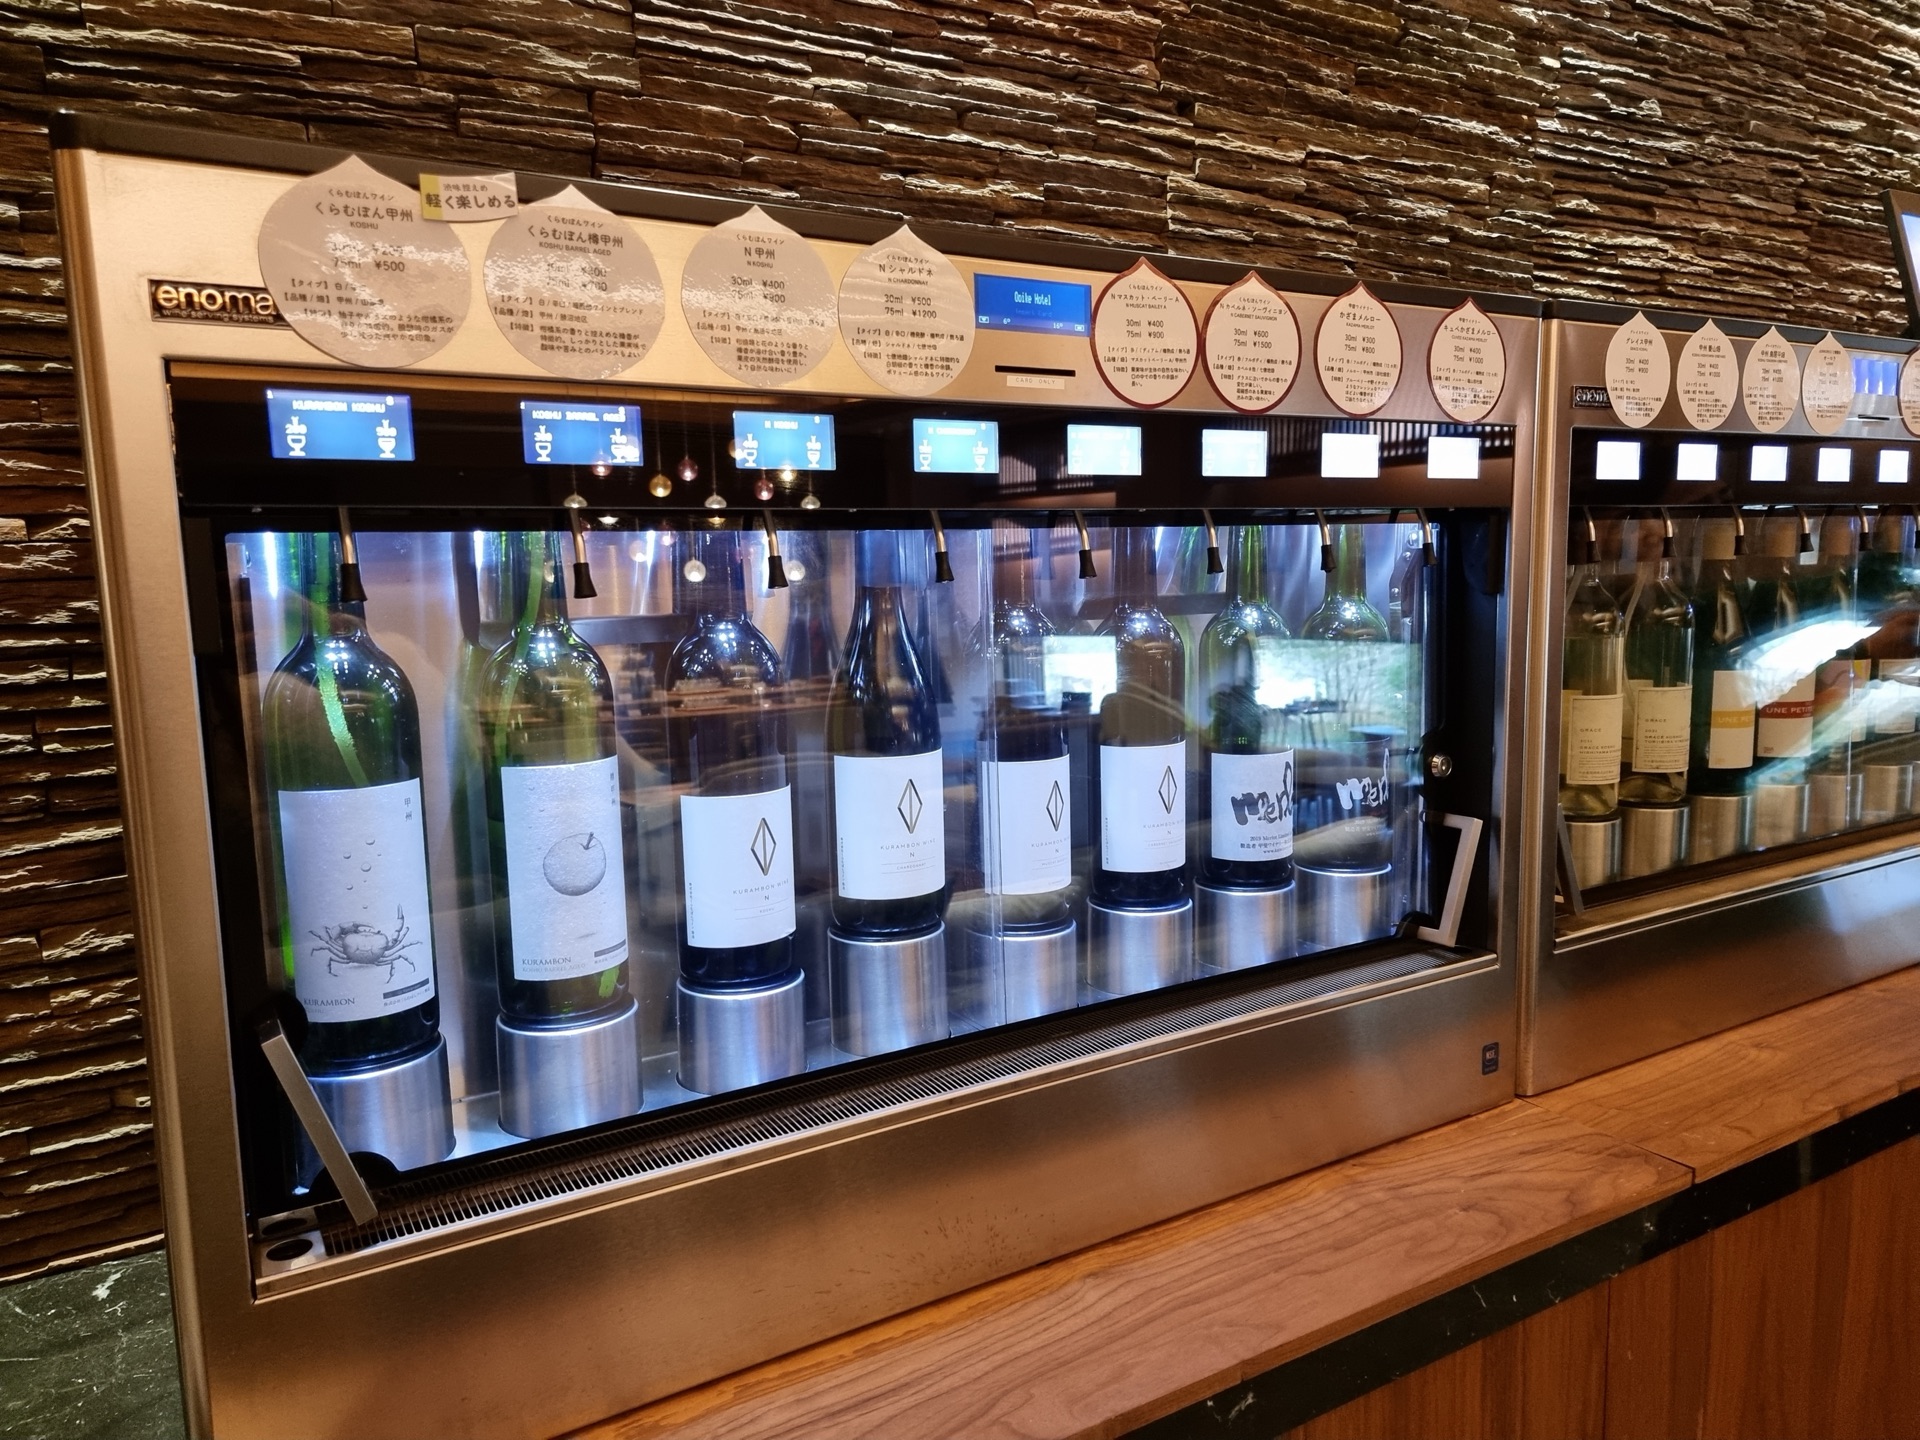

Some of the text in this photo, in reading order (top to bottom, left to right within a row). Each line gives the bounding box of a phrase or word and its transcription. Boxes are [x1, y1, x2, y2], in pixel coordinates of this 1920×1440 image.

[425, 192, 516, 210] 軽く楽しめる
[350, 221, 379, 230] KOSHU
[539, 241, 612, 256] KOSHU BARREL AGED
[744, 246, 776, 260] N 甲州
[374, 260, 406, 272] ¥500
[752, 261, 774, 269] KOSHU
[879, 263, 934, 277] N シャルドネ
[731, 275, 785, 290] 30ml ¥400
[893, 277, 929, 286] CHARDONNAY
[884, 293, 932, 306] 30ml ¥500
[1034, 293, 1051, 306] Hotel
[162, 309, 275, 323] wine serving systems
[884, 307, 937, 319] 75ml ¥1200
[1340, 312, 1381, 321] かざまメルロー
[1126, 319, 1164, 328] 30ml ¥400
[1126, 330, 1164, 339] 75ml ¥900
[1233, 328, 1269, 338] 30ml ¥600
[1233, 339, 1272, 349] 75ml ¥1500
[1362, 336, 1375, 344] ¥300
[1345, 344, 1357, 352] 75ml
[1766, 706, 1787, 714] UNE
[404, 797, 412, 822] 甲州
[880, 842, 920, 850] KURAMBON
[733, 884, 775, 895] KURAMBON
[521, 956, 572, 967] KURAMBON
[303, 997, 355, 1007] KURAMBON
